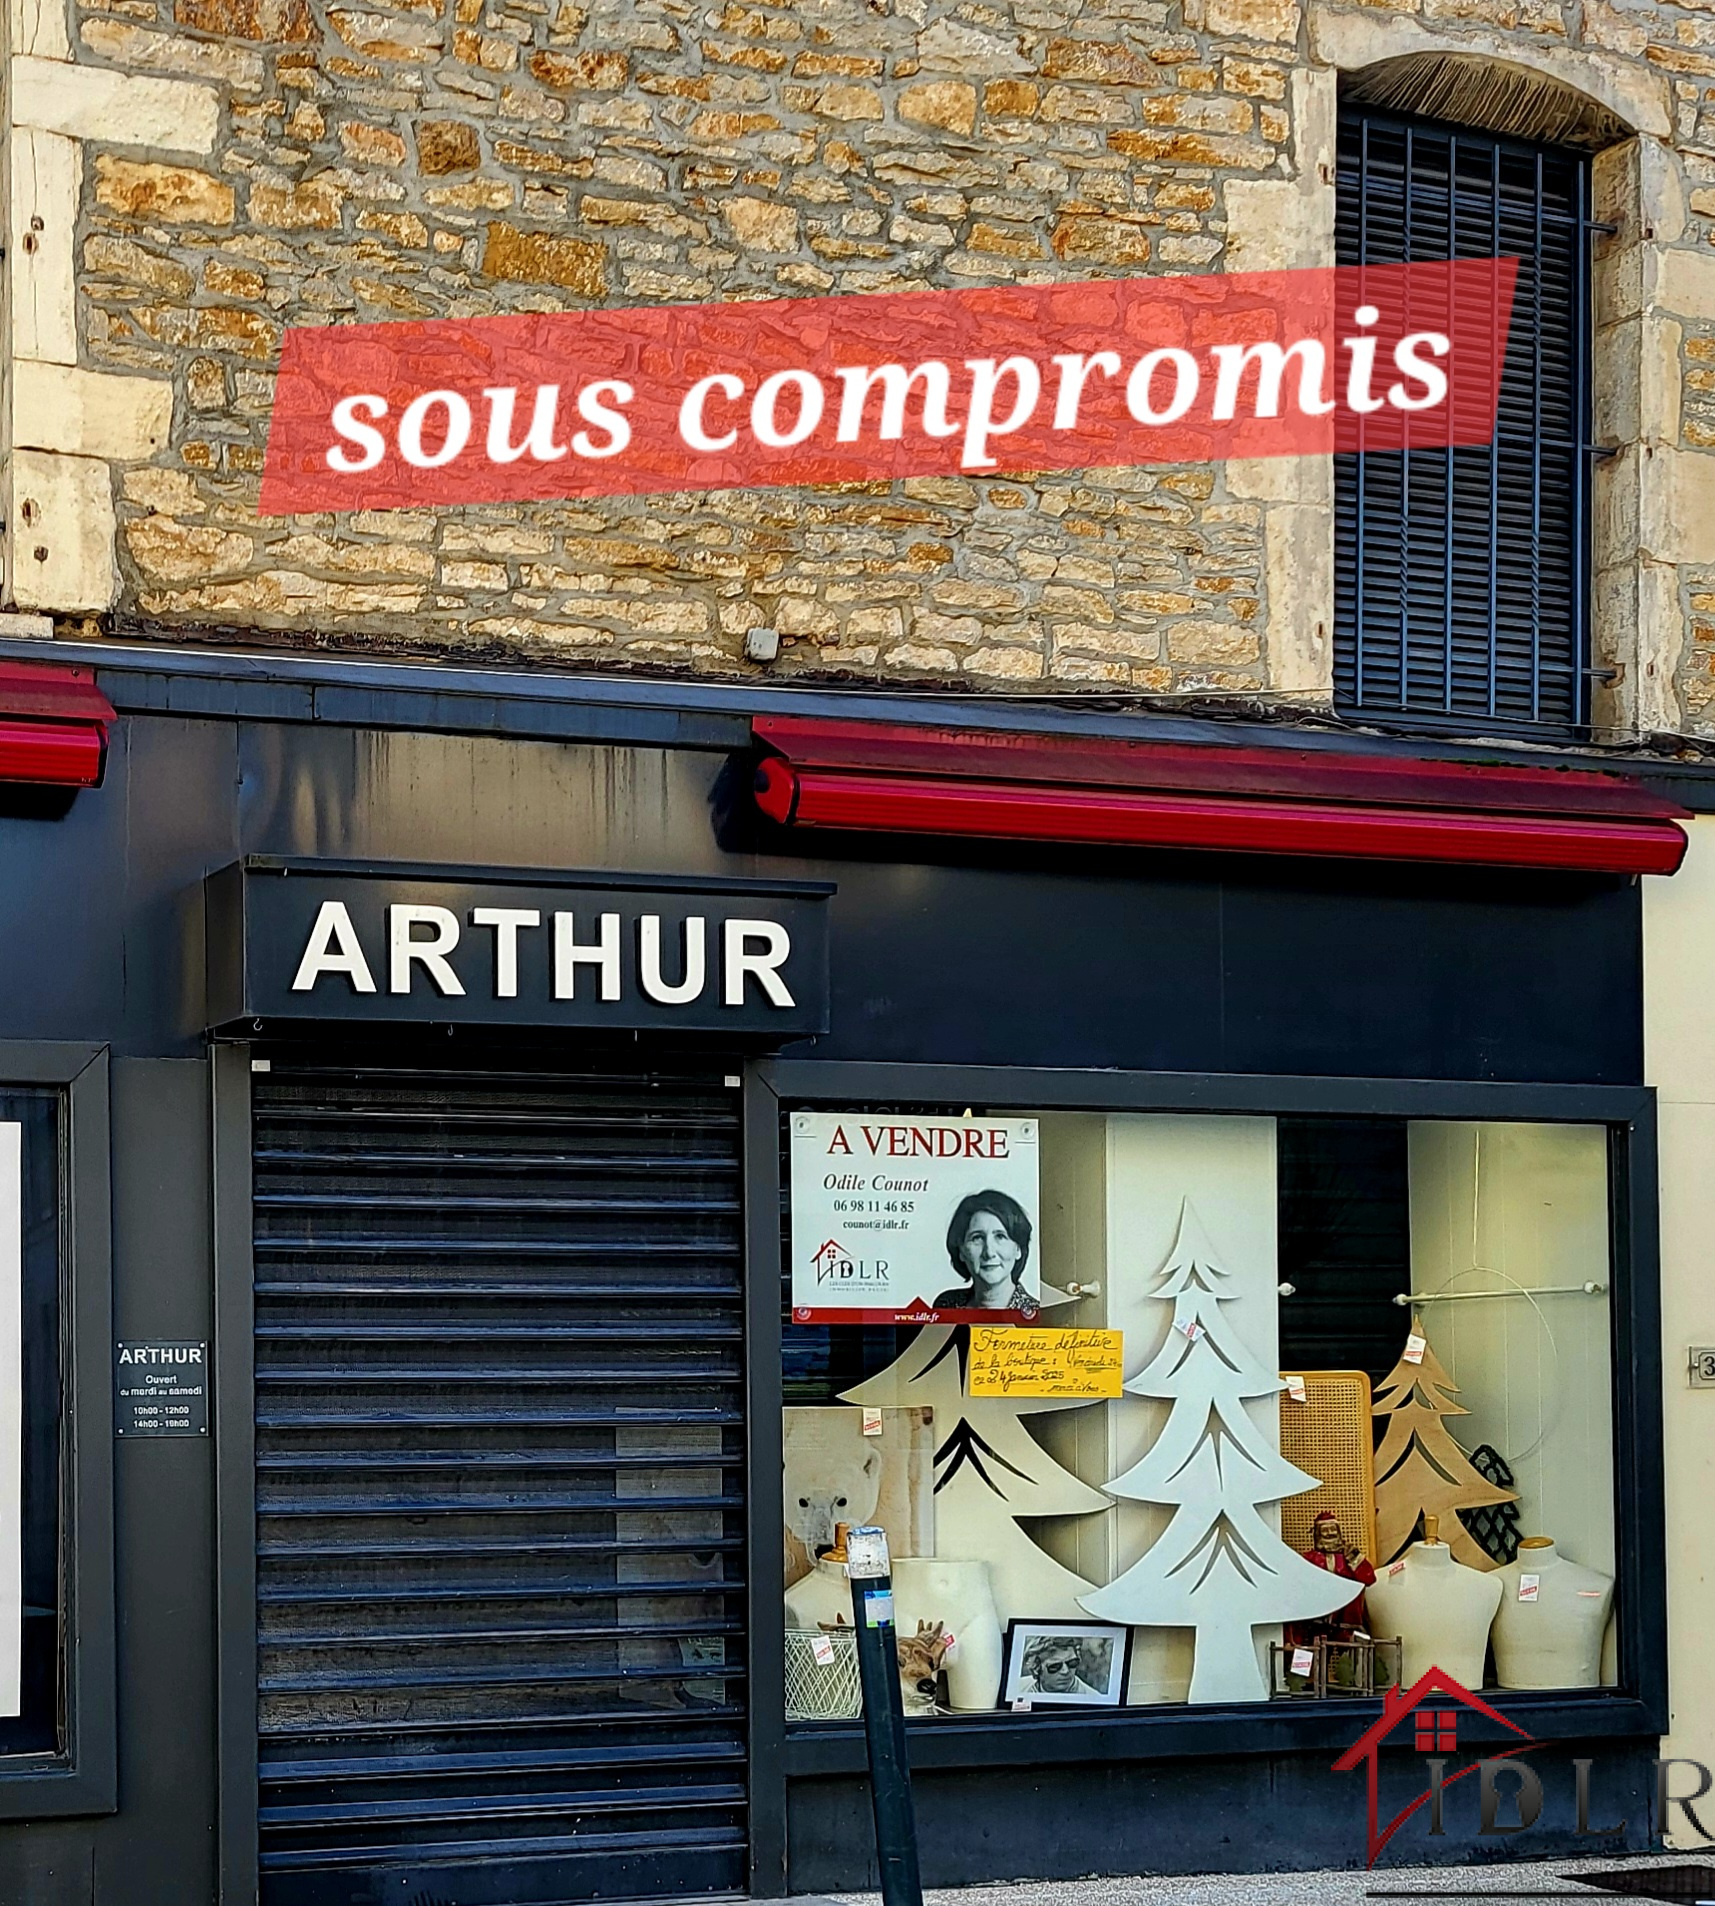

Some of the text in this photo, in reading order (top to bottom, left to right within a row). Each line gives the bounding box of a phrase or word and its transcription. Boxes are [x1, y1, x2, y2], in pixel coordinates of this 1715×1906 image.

[291, 899, 798, 1009] ARTHUR
[826, 1124, 1011, 1159] A VENDRE
[823, 1173, 929, 1193] Odile Counot
[833, 1199, 915, 1214] 06 98 11 46 85
[842, 1219, 910, 1232] counot@idlr.fr
[829, 1259, 890, 1281] IDLR
[894, 1311, 940, 1323] www.idlr.fr
[119, 1347, 203, 1364] ARTHUR
[145, 1374, 178, 1384] Ouvert
[120, 1388, 130, 1396] du
[130, 1386, 158, 1396] mardi
[168, 1386, 203, 1396] samedi
[133, 1406, 159, 1415] 10h00
[164, 1406, 190, 1414] 12h00
[133, 1419, 159, 1428] 14h00
